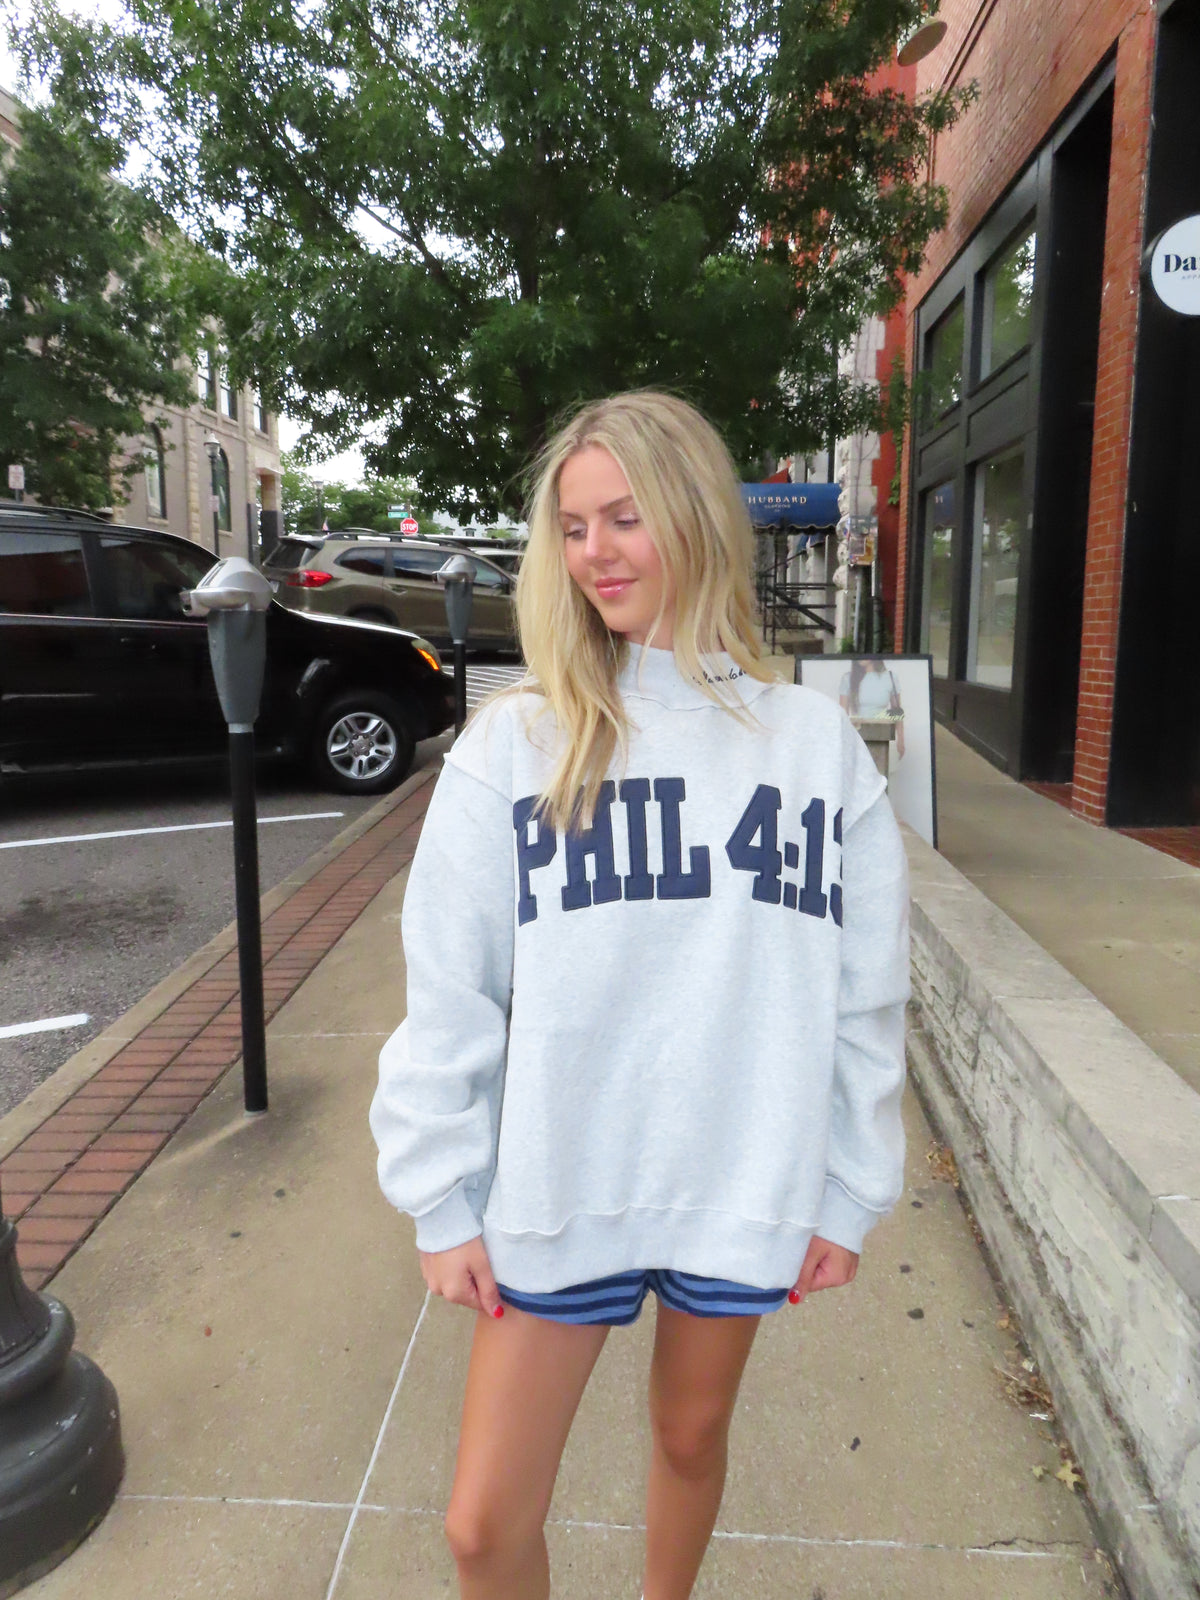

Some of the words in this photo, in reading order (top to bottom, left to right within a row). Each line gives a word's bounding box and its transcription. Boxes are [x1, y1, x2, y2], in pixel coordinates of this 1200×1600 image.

[1163, 254, 1200, 273] Da
[748, 496, 807, 504] HUBBARD
[402, 523, 417, 531] STOP
[513, 777, 711, 927] PHIL
